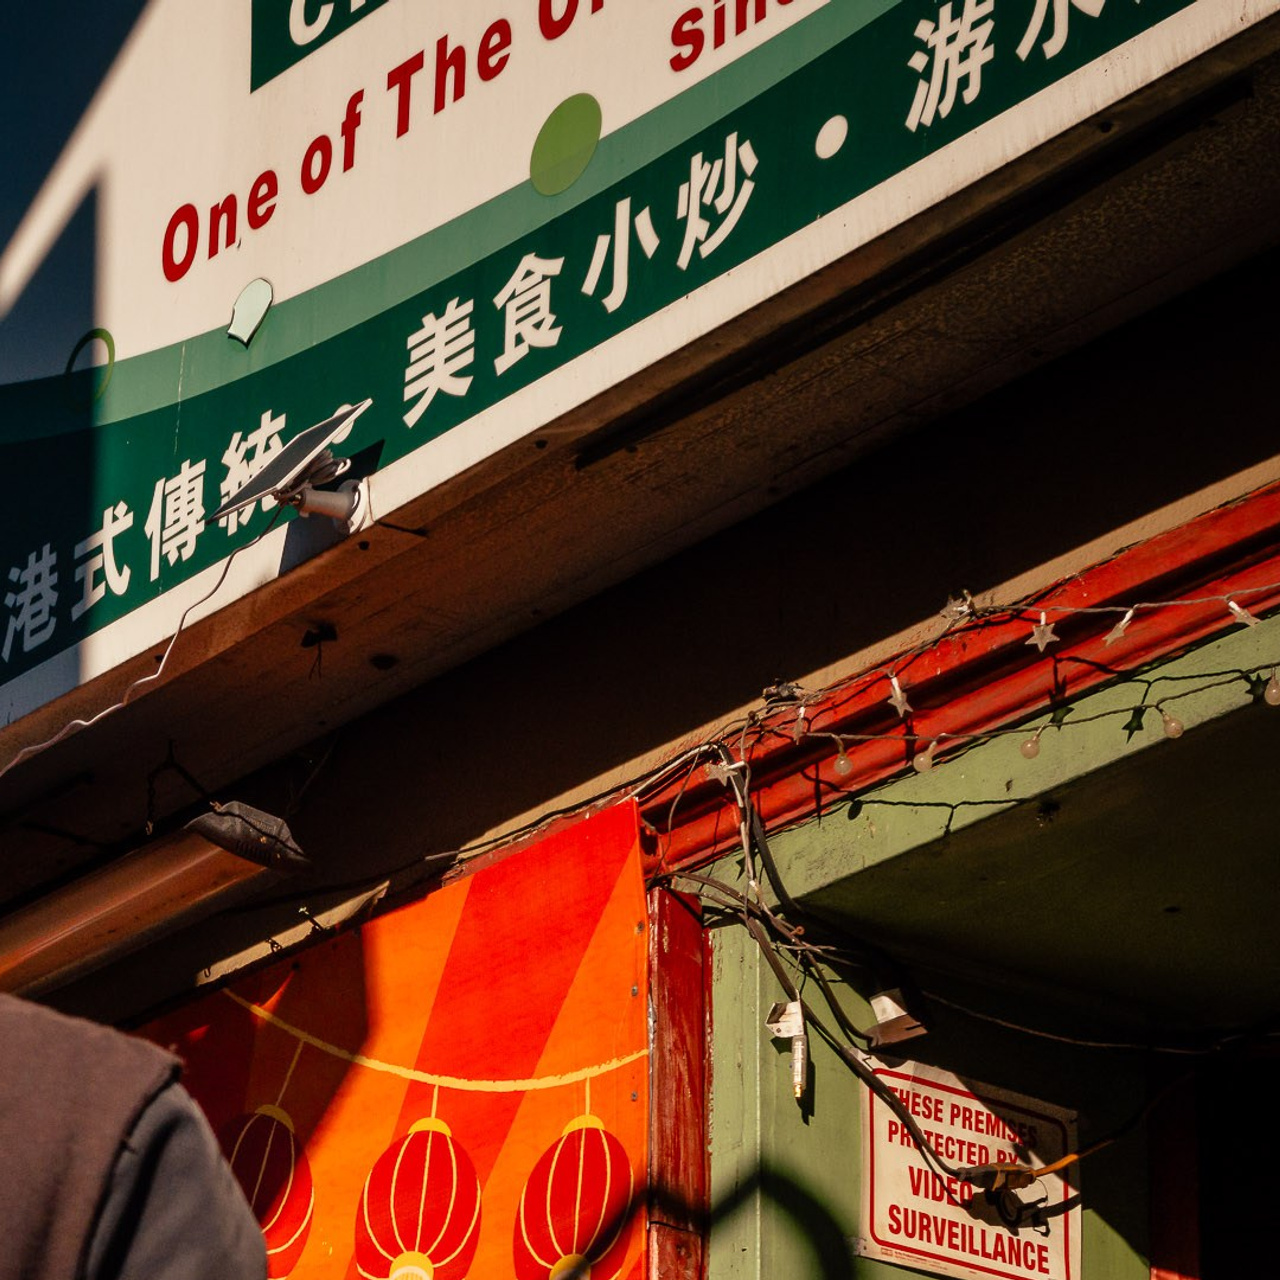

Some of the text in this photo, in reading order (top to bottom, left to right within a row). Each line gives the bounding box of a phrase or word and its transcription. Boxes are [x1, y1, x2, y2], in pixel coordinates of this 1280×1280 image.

[161, 169, 279, 284] One
[300, 88, 365, 196] of
[386, 17, 513, 140] The
[888, 1119, 989, 1166] PRTECTED
[950, 1102, 1038, 1149] PREMISES
[888, 1204, 1050, 1275] SURVEILLANCE
